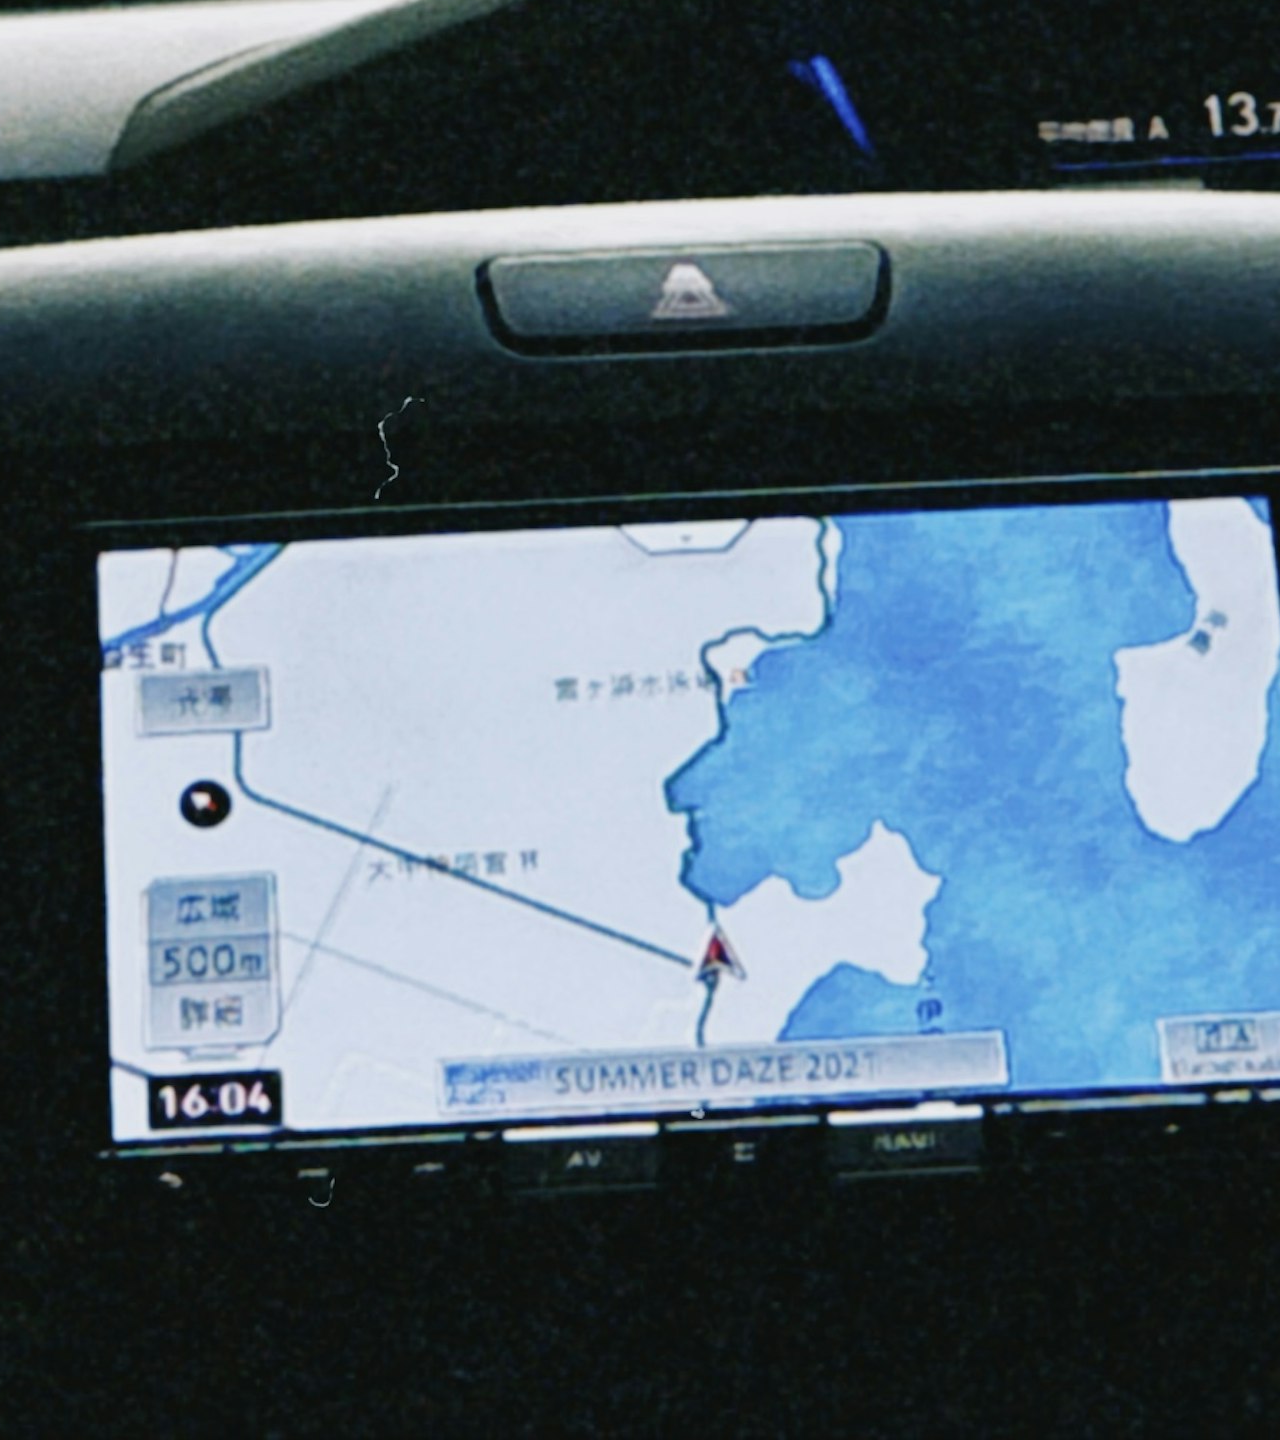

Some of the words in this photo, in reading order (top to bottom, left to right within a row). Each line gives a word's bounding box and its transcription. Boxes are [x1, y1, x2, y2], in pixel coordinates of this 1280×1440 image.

[163, 942, 262, 980] 500m
[554, 1058, 701, 1095] SUMMER
[710, 1054, 796, 1086] DAZE
